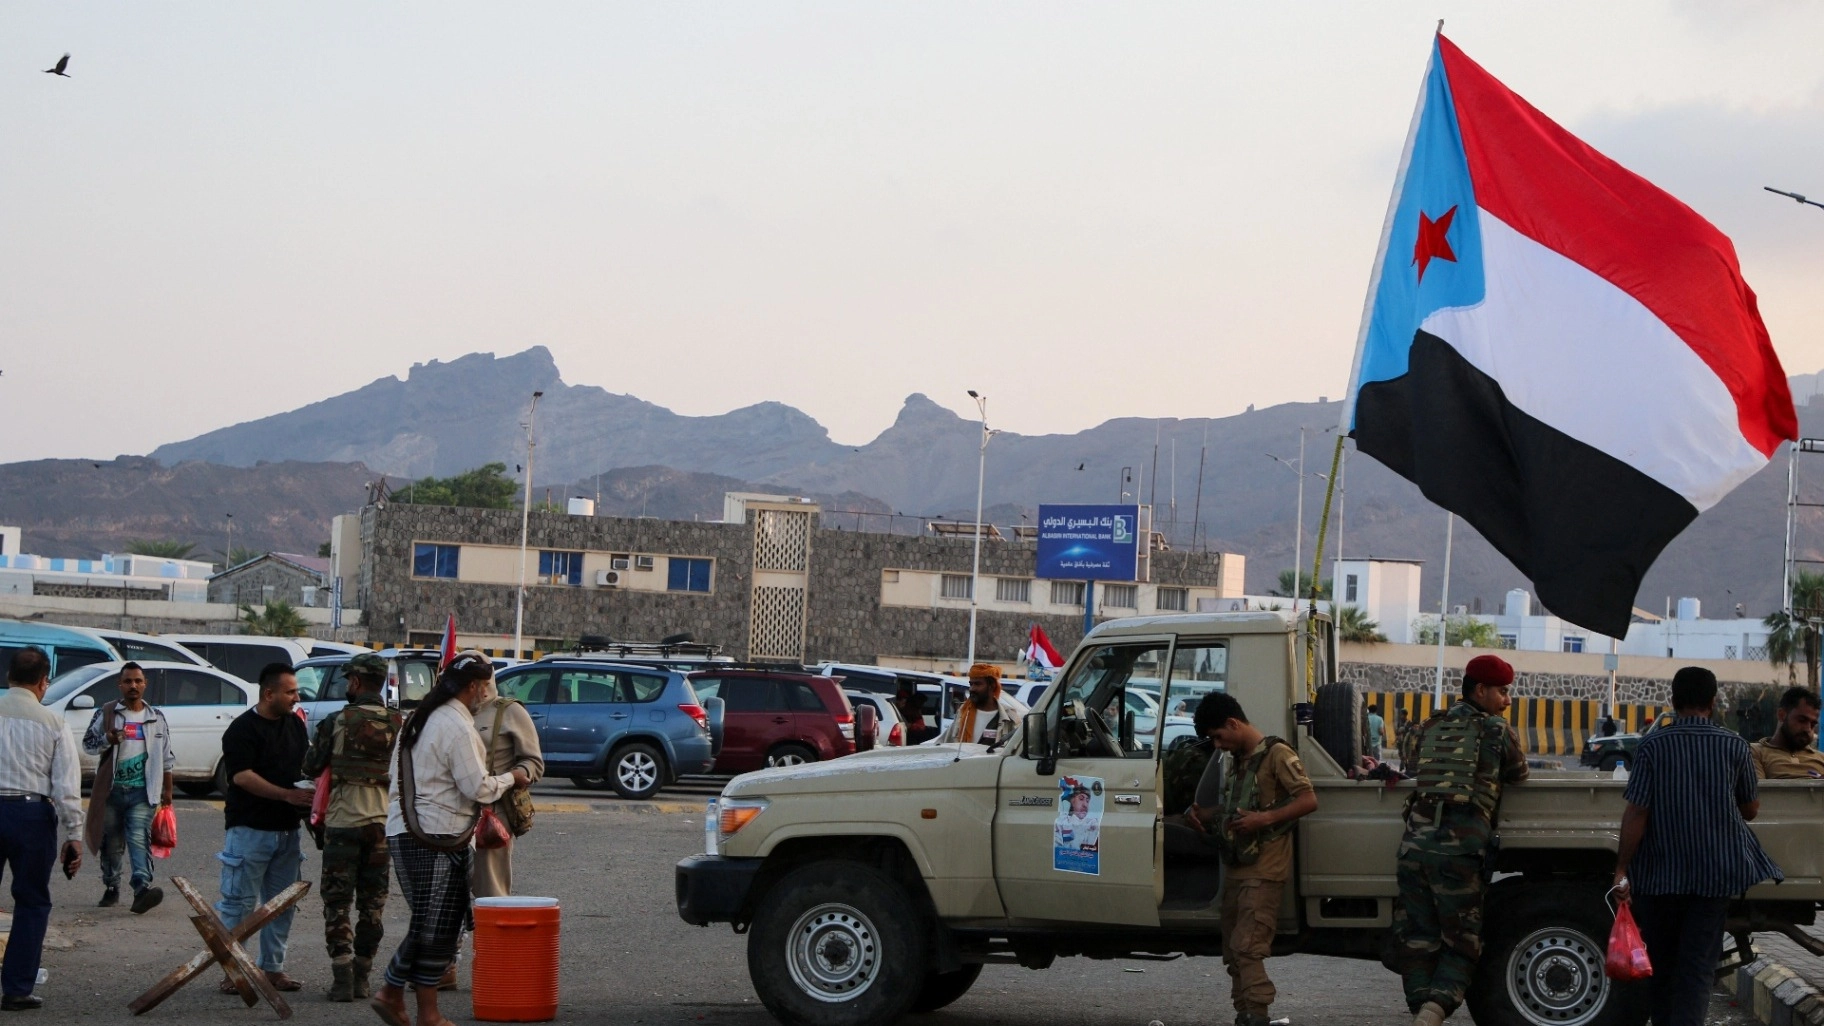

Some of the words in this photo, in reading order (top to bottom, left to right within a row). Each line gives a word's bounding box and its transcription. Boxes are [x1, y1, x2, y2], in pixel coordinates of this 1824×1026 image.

[1043, 516, 1066, 529] الدولي
[1067, 517, 1099, 530] البسيري
[1100, 517, 1112, 529] بنك
